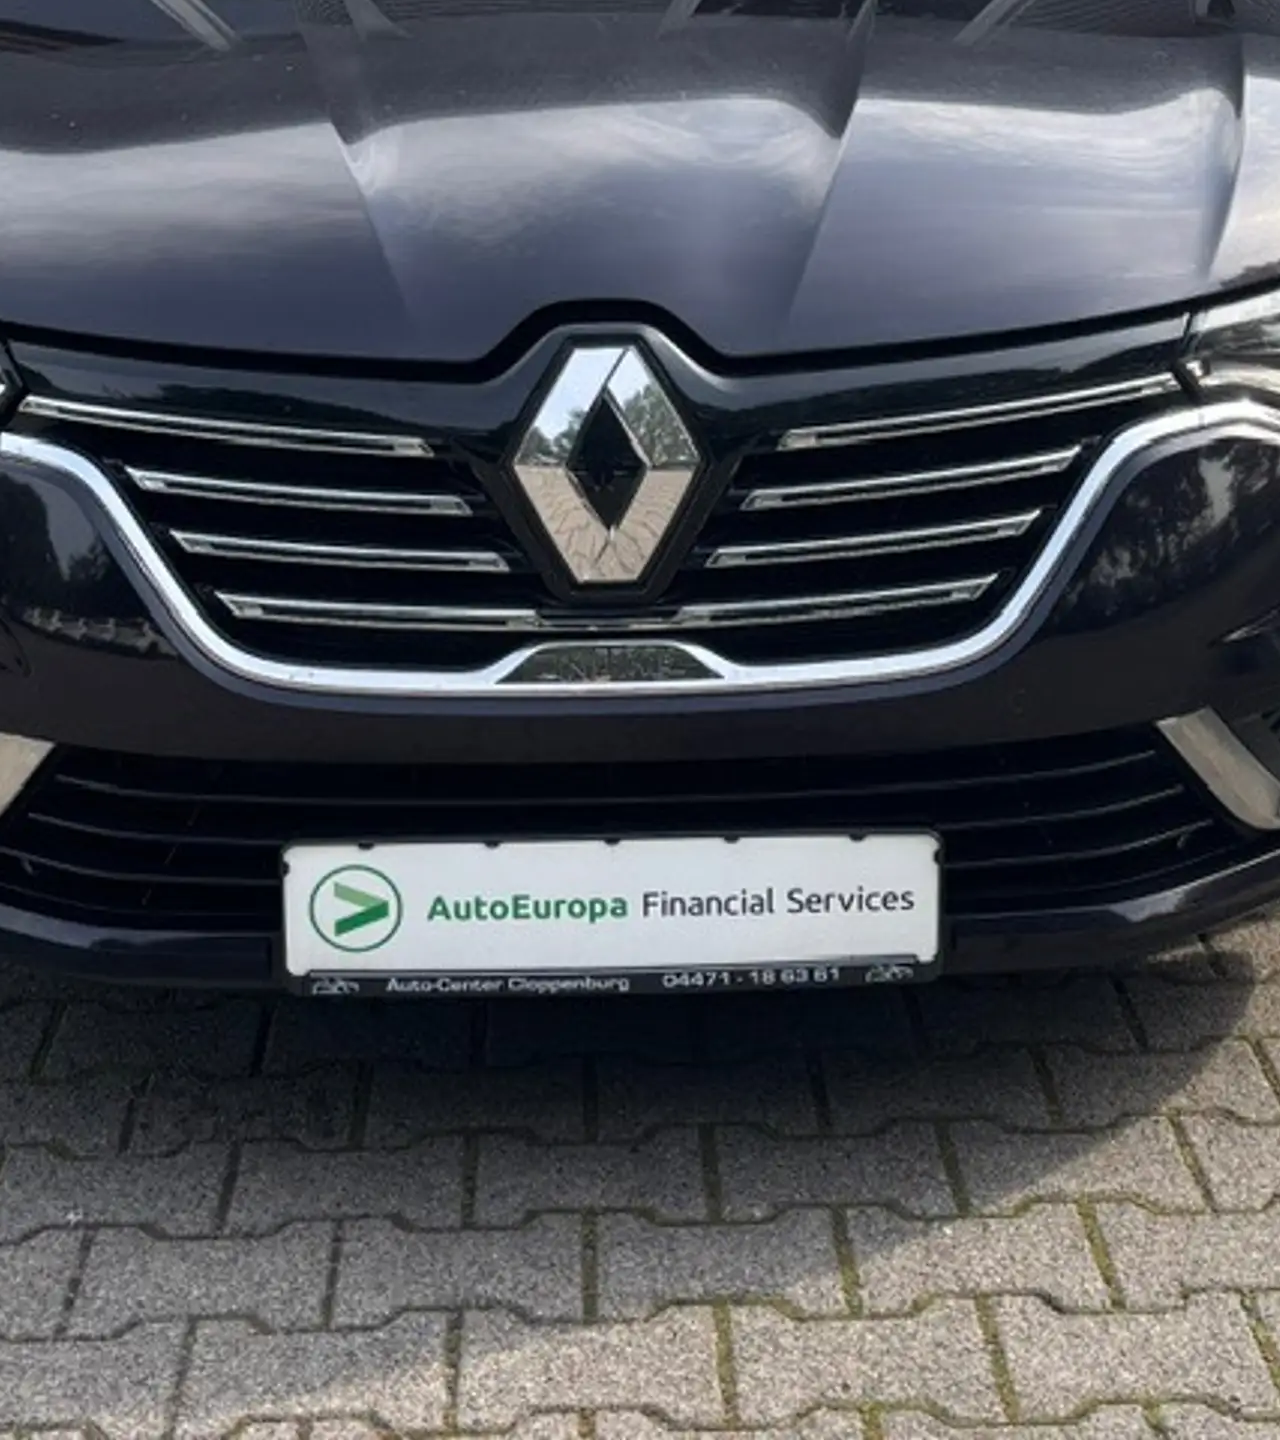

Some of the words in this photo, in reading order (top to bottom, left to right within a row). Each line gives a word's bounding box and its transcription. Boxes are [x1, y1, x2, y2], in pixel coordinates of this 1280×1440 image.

[426, 893, 629, 924] AutoEuropa
[642, 887, 774, 917] Financial
[786, 885, 915, 914] Services
[386, 977, 504, 993] Auto-Center
[508, 976, 630, 993] Cloppenburg
